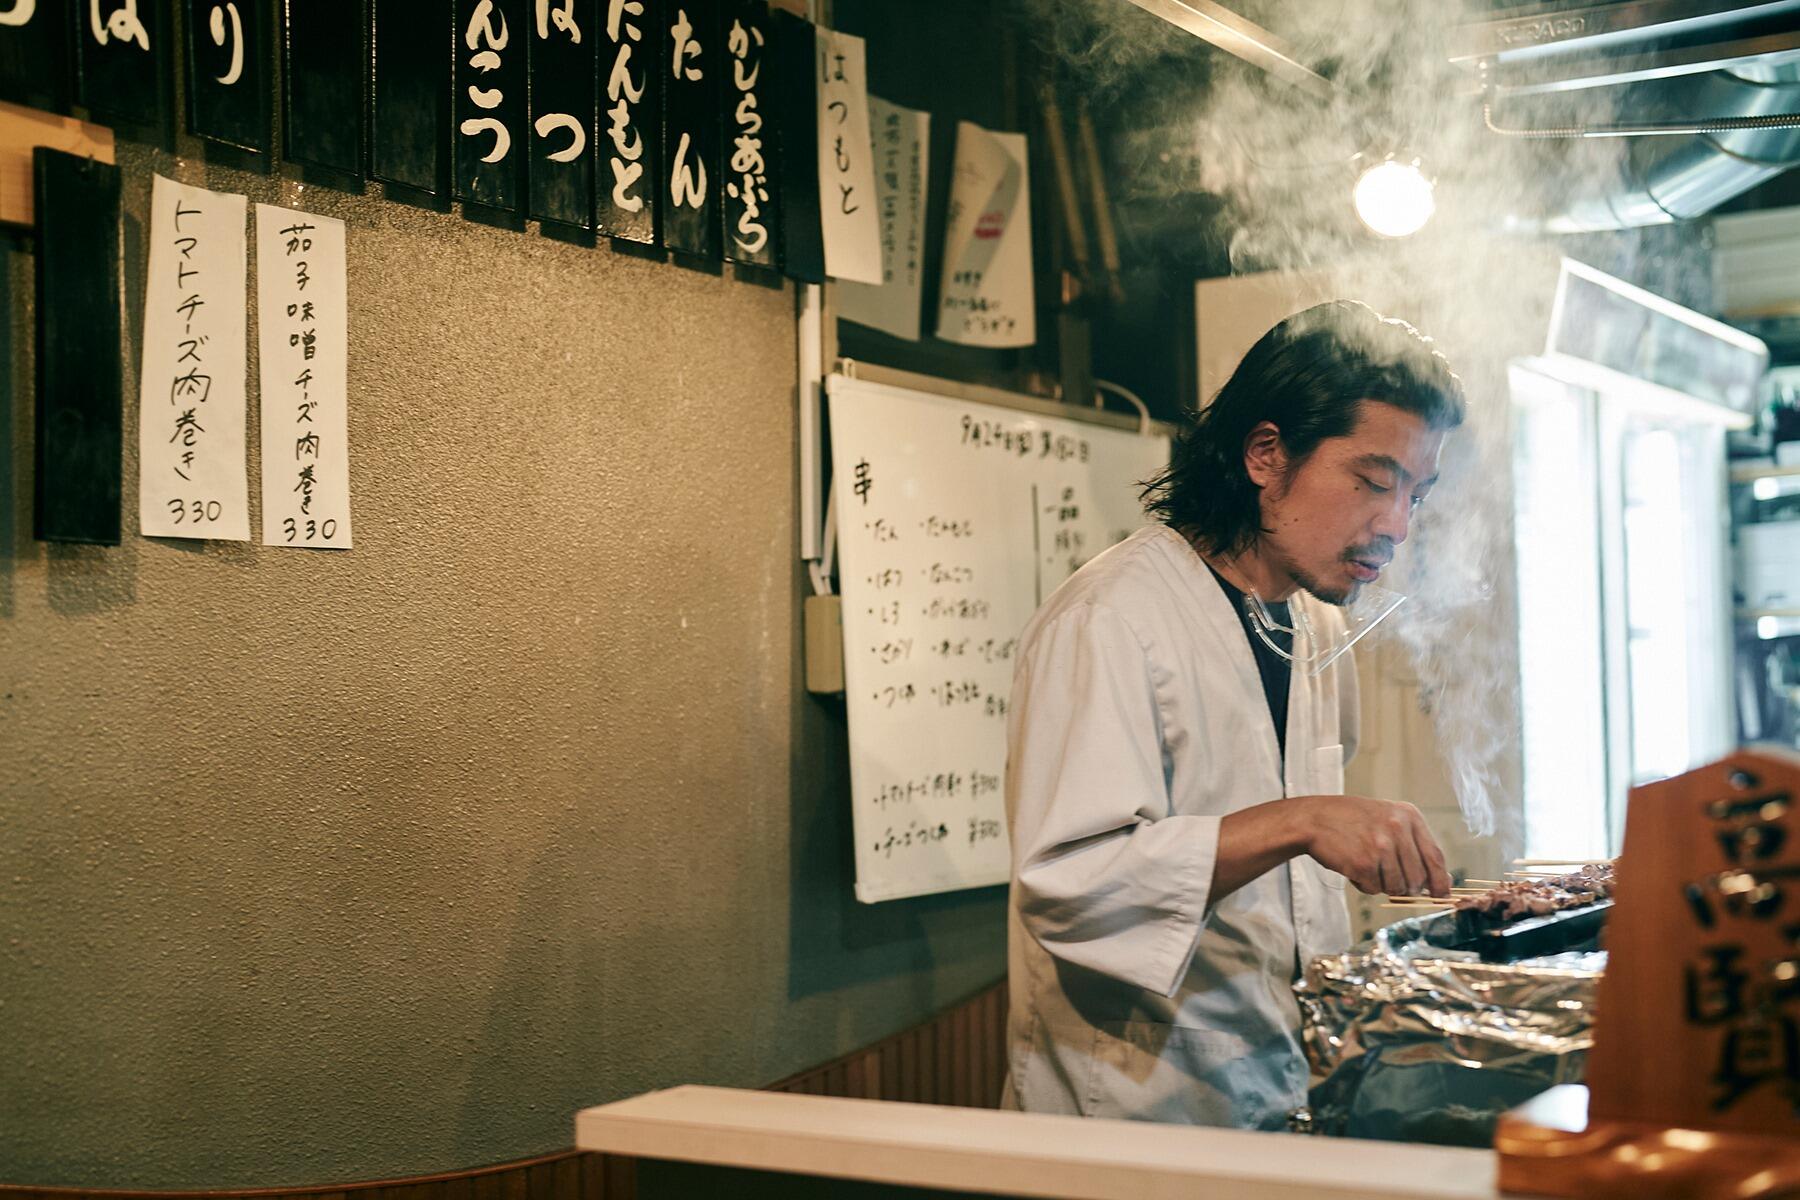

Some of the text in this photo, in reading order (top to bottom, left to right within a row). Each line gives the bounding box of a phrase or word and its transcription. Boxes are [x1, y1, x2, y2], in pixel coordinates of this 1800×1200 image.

[671, 9, 707, 209] たん
[728, 19, 769, 253] かしらあぶら
[827, 52, 859, 215] はつもと
[167, 199, 222, 524] トマトチーズ肉巻き 330
[279, 222, 337, 542] 茄子味噌チーズ肉巻き 330
[854, 457, 872, 505] 串
